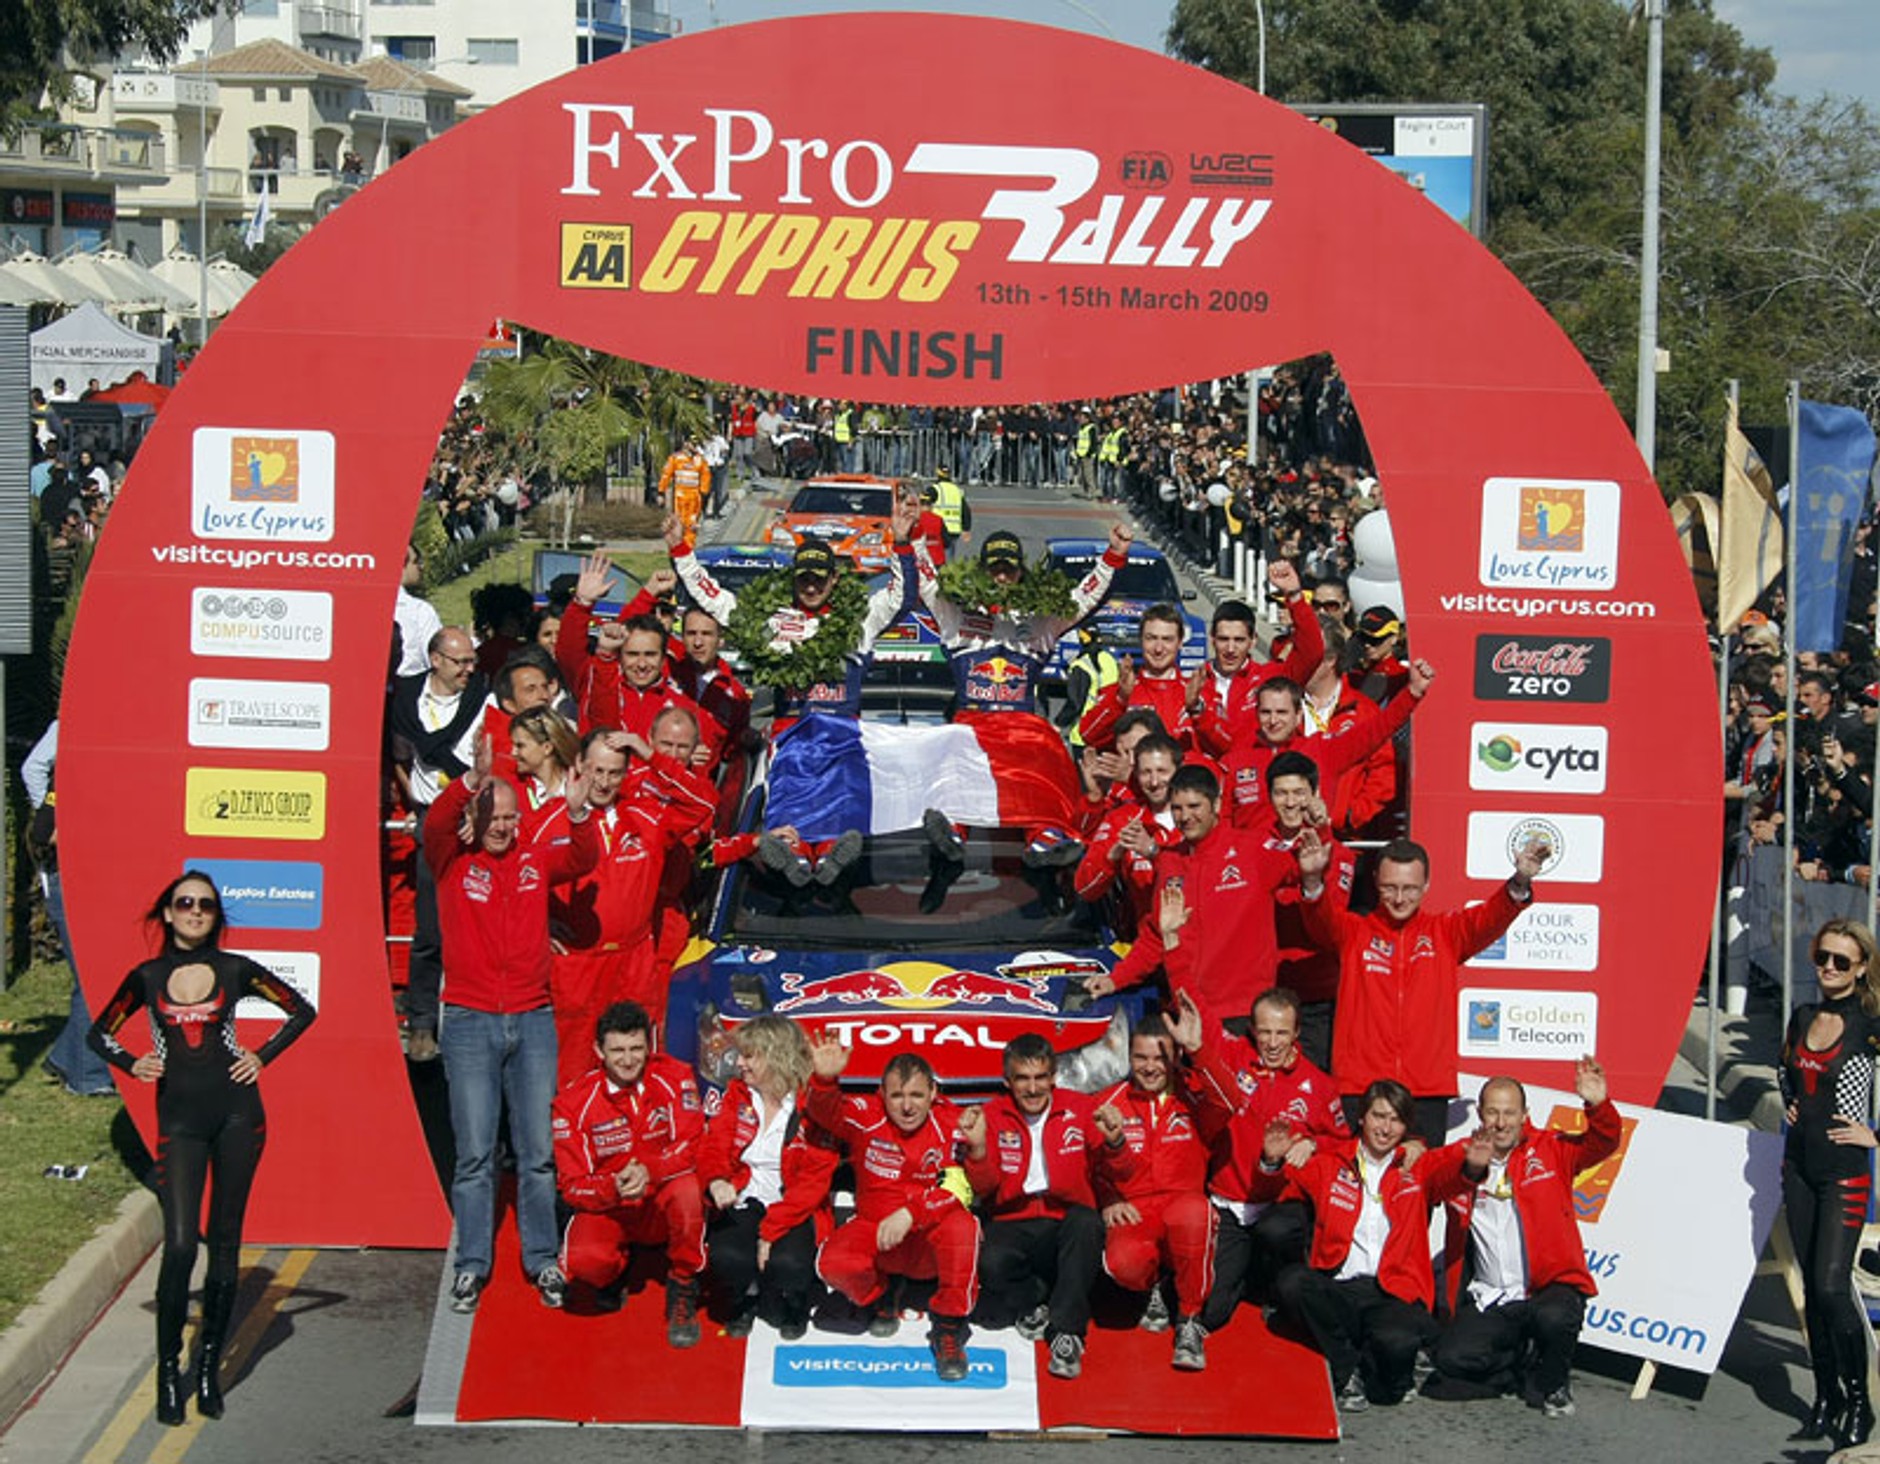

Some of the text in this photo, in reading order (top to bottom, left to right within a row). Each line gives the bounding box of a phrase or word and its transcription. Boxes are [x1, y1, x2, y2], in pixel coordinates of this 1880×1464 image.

[560, 102, 894, 208] FxPro
[1190, 153, 1274, 173] WRC
[903, 143, 1274, 268] RALLY
[583, 230, 625, 242] CYPRUS
[567, 243, 625, 283] AA
[639, 211, 980, 302] CYPRUS
[976, 283, 1031, 305] 13th
[1056, 286, 1111, 309] 15th
[1120, 287, 1200, 310] March
[1208, 289, 1269, 312] 2009
[33, 346, 69, 358] FICIAL
[806, 327, 1003, 380] FINISH
[251, 506, 326, 537] Cyprus
[152, 545, 375, 569] visitcyprus.com
[1537, 555, 1608, 585] Cyprus
[1440, 593, 1655, 618] visitcyprus.com
[1491, 641, 1594, 676] Coca-Cola
[1507, 676, 1571, 696] zero
[229, 700, 322, 719] TRAVELSCOPE
[1525, 743, 1600, 780] cyta
[222, 885, 316, 901] Leptos Estates
[1513, 931, 1588, 946] SEASONS
[1527, 949, 1573, 960] HOTEL
[1507, 1006, 1586, 1024] Golden
[826, 1020, 1007, 1049] TOTAL
[1507, 1027, 1585, 1044] Telecom
[1586, 1304, 1708, 1354] us.com
[788, 1359, 994, 1375] visitcyprus.m
